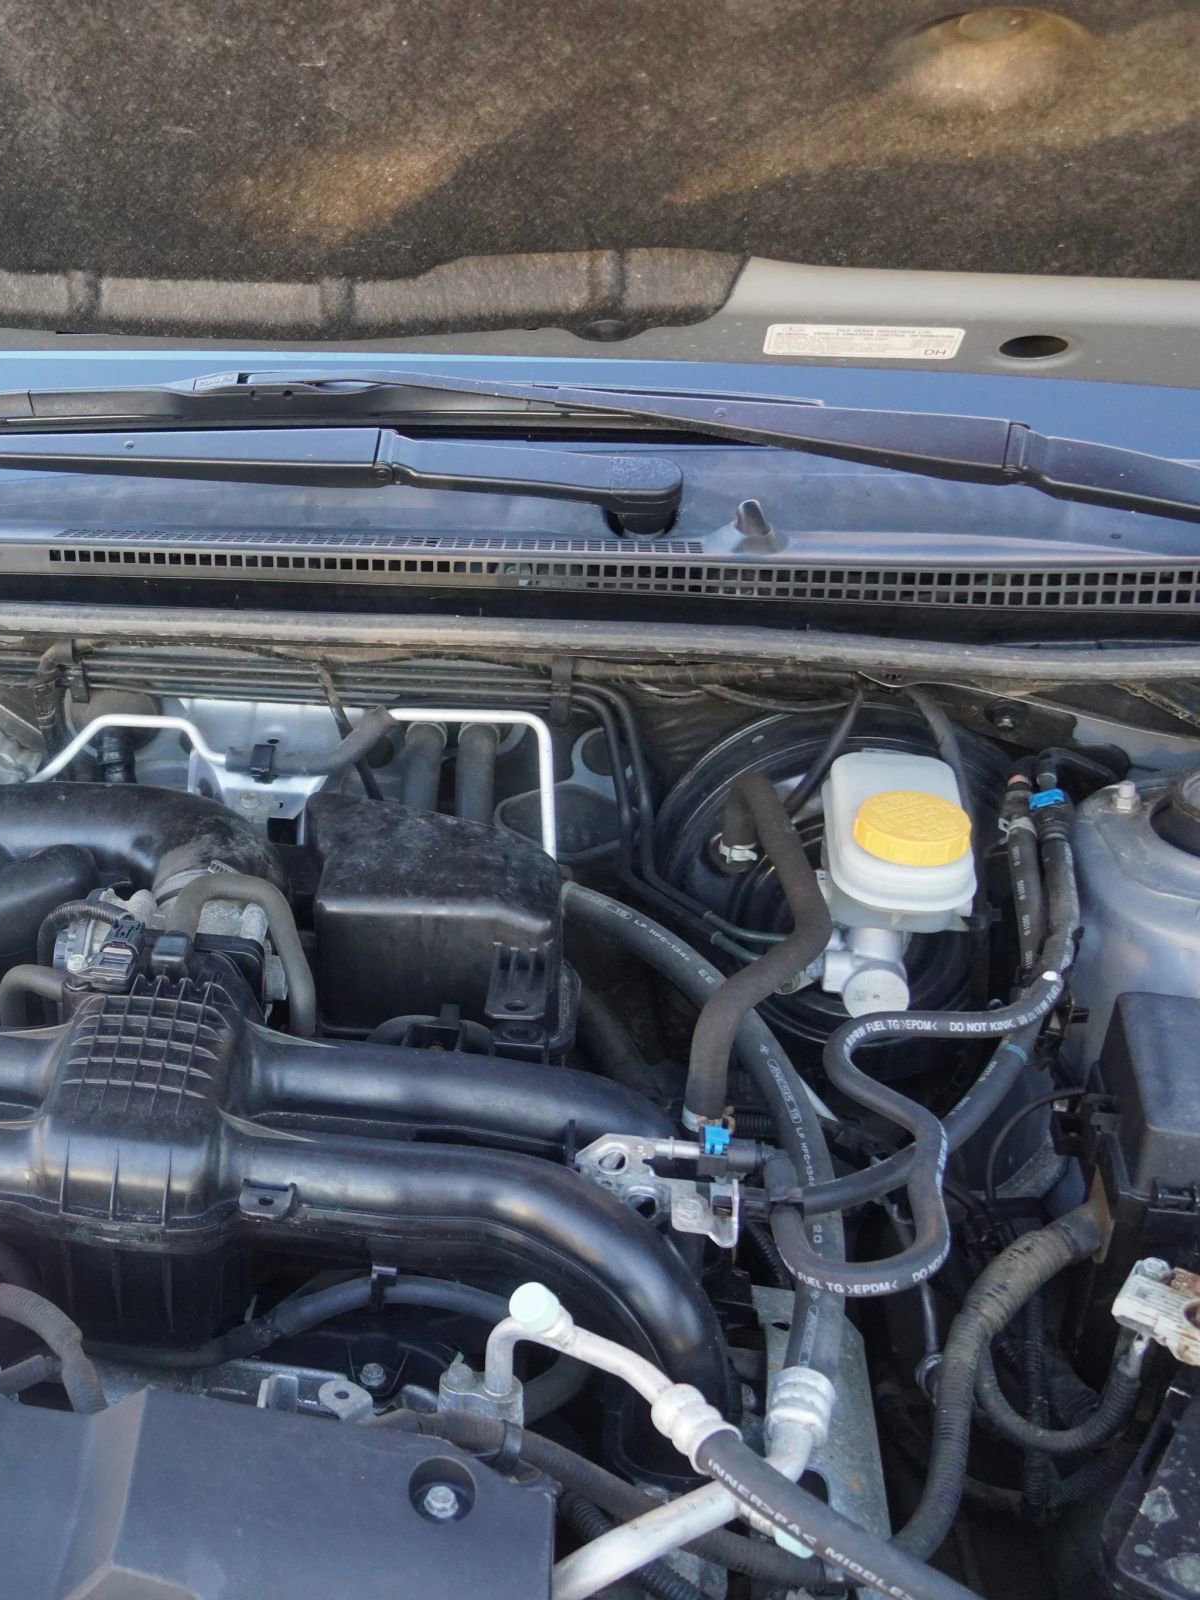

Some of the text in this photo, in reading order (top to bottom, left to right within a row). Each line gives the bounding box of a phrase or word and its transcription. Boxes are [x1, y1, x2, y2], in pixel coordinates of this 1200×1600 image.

[923, 348, 947, 357] DH
[866, 1020, 887, 1033] FUEL
[887, 1019, 900, 1030] TG
[949, 1021, 965, 1032] DO
[966, 1021, 988, 1033] NOT
[797, 1271, 824, 1290] FUEL
[825, 1281, 845, 1294] TG
[911, 1269, 929, 1283] DO
